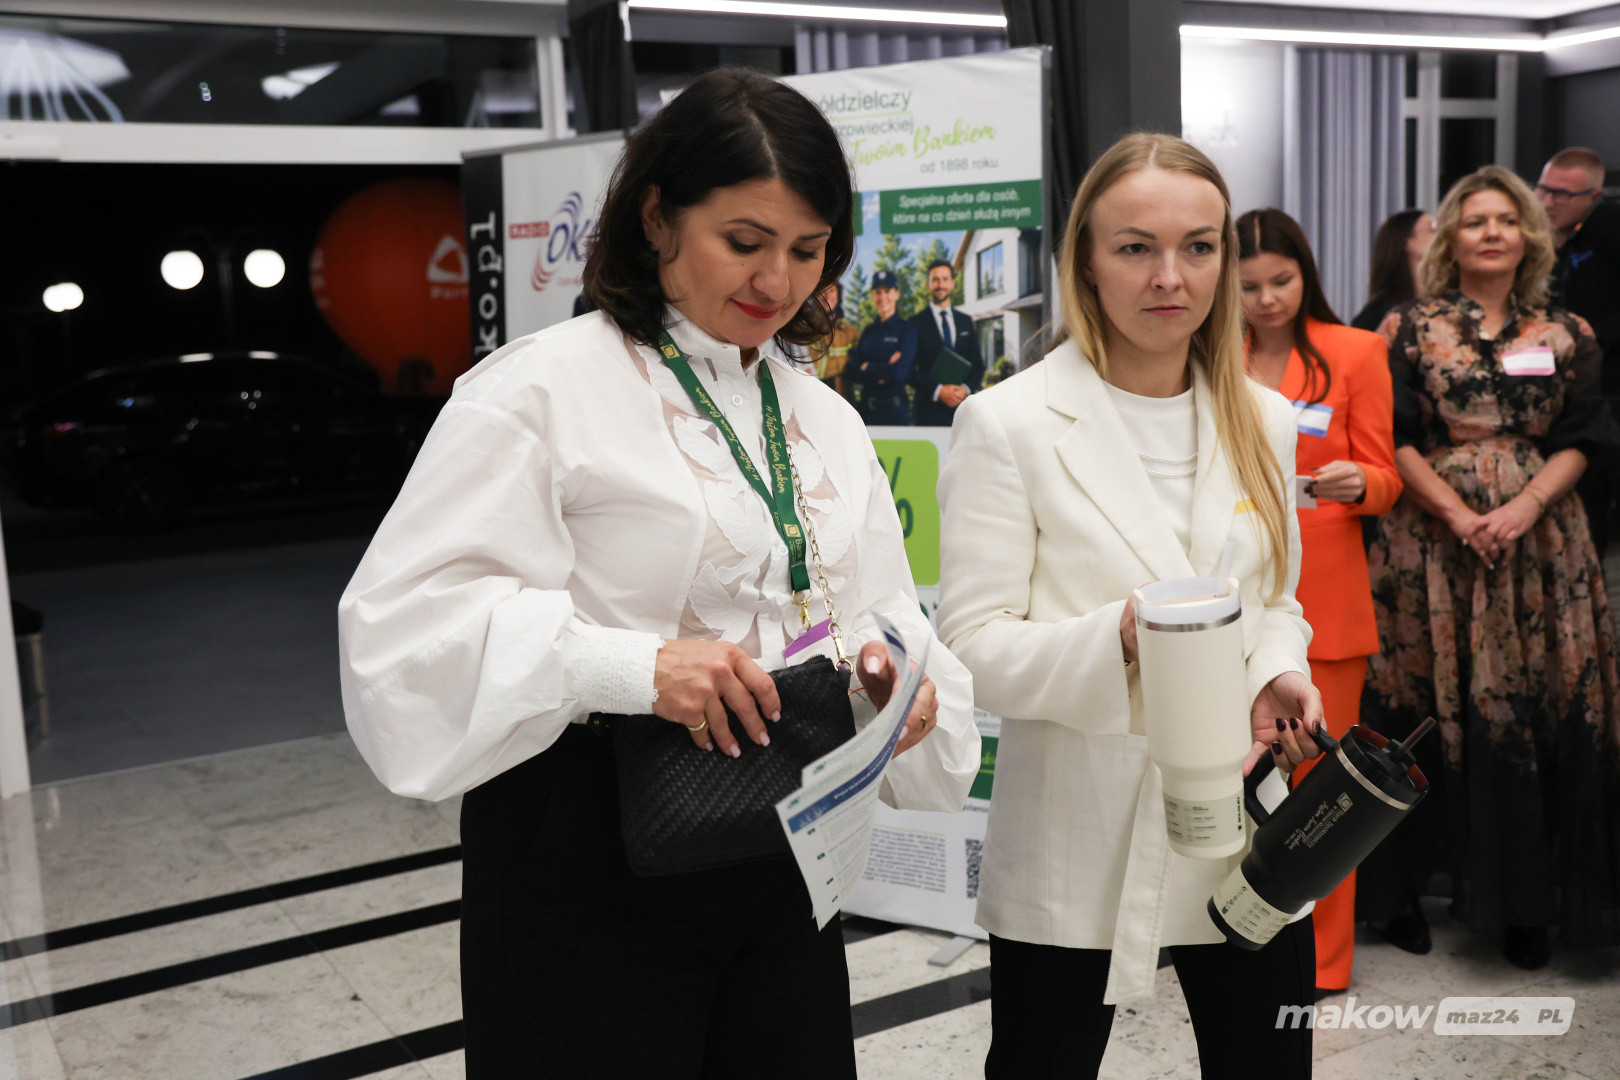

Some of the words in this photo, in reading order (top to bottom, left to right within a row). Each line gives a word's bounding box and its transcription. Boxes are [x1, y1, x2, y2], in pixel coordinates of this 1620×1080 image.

[820, 90, 912, 113] ółdzielczy
[838, 117, 914, 137] zowieckiej
[913, 117, 999, 159] Bankiem
[971, 156, 999, 170] roku
[946, 191, 975, 205] oferta
[976, 190, 991, 203] dla
[918, 213, 930, 224] na
[931, 212, 944, 222] co
[1001, 206, 1031, 221] innym
[509, 222, 549, 239] RADIO
[547, 218, 594, 263] OK
